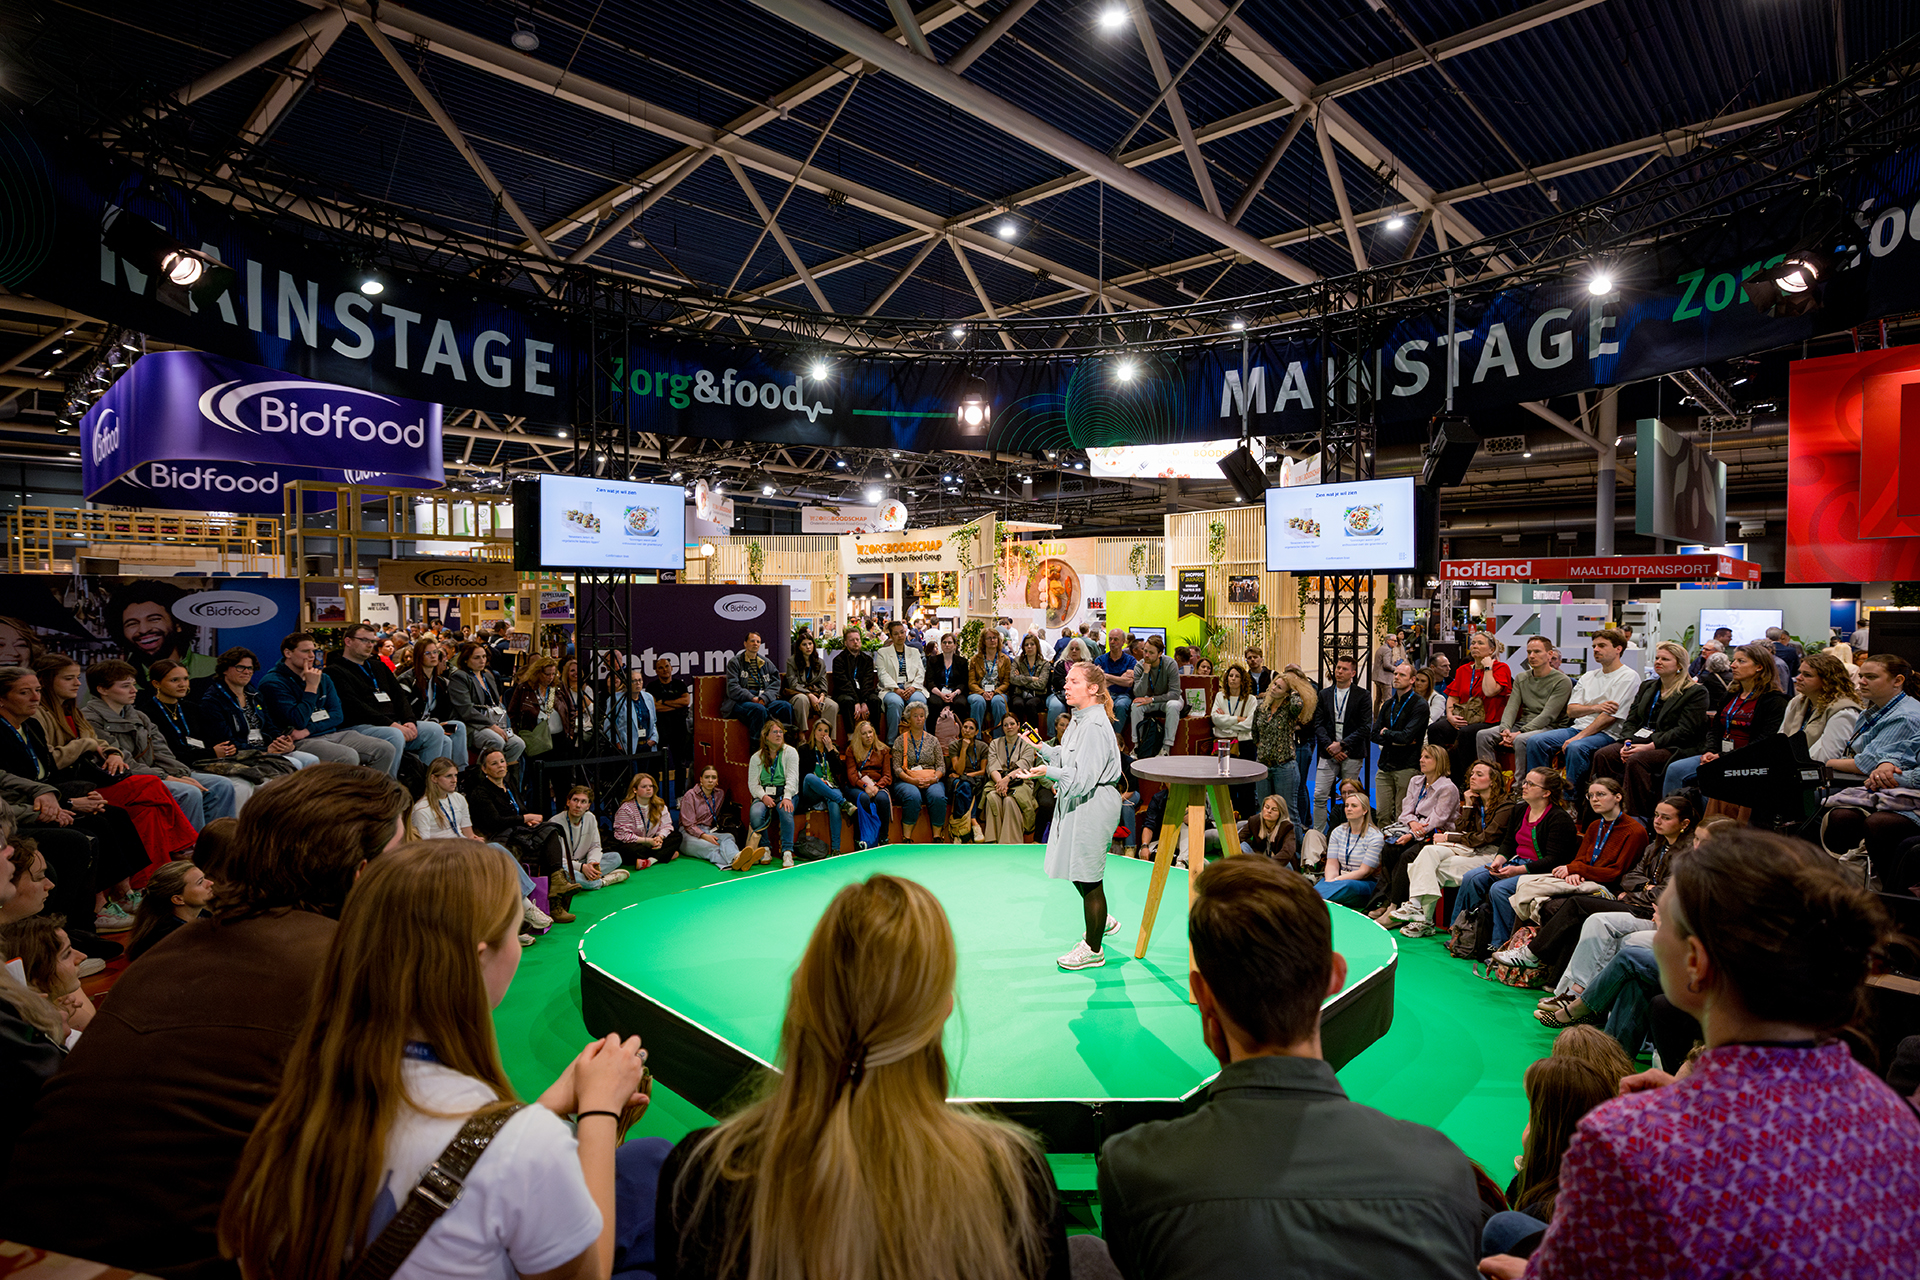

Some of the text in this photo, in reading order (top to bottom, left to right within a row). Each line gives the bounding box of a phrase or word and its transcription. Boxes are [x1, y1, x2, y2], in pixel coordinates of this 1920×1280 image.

[610, 356, 804, 410] Zorg&food
[260, 396, 425, 448] Bidfood
[97, 416, 119, 463] Bidfood
[150, 462, 279, 494] Bidfood
[863, 540, 943, 556] ZORGBOODSCHAP
[857, 555, 884, 564] Onderdeel
[894, 555, 909, 563] Boon
[909, 553, 923, 562] Food
[924, 552, 942, 562] Group
[1446, 561, 1532, 578] hofland
[1570, 563, 1711, 577] MAALTIJDTRANSPORT
[432, 573, 488, 587] Bidfood
[206, 605, 261, 617] Bidfood
[730, 604, 758, 612] Bidfood
[1724, 767, 1769, 778] SHURE
